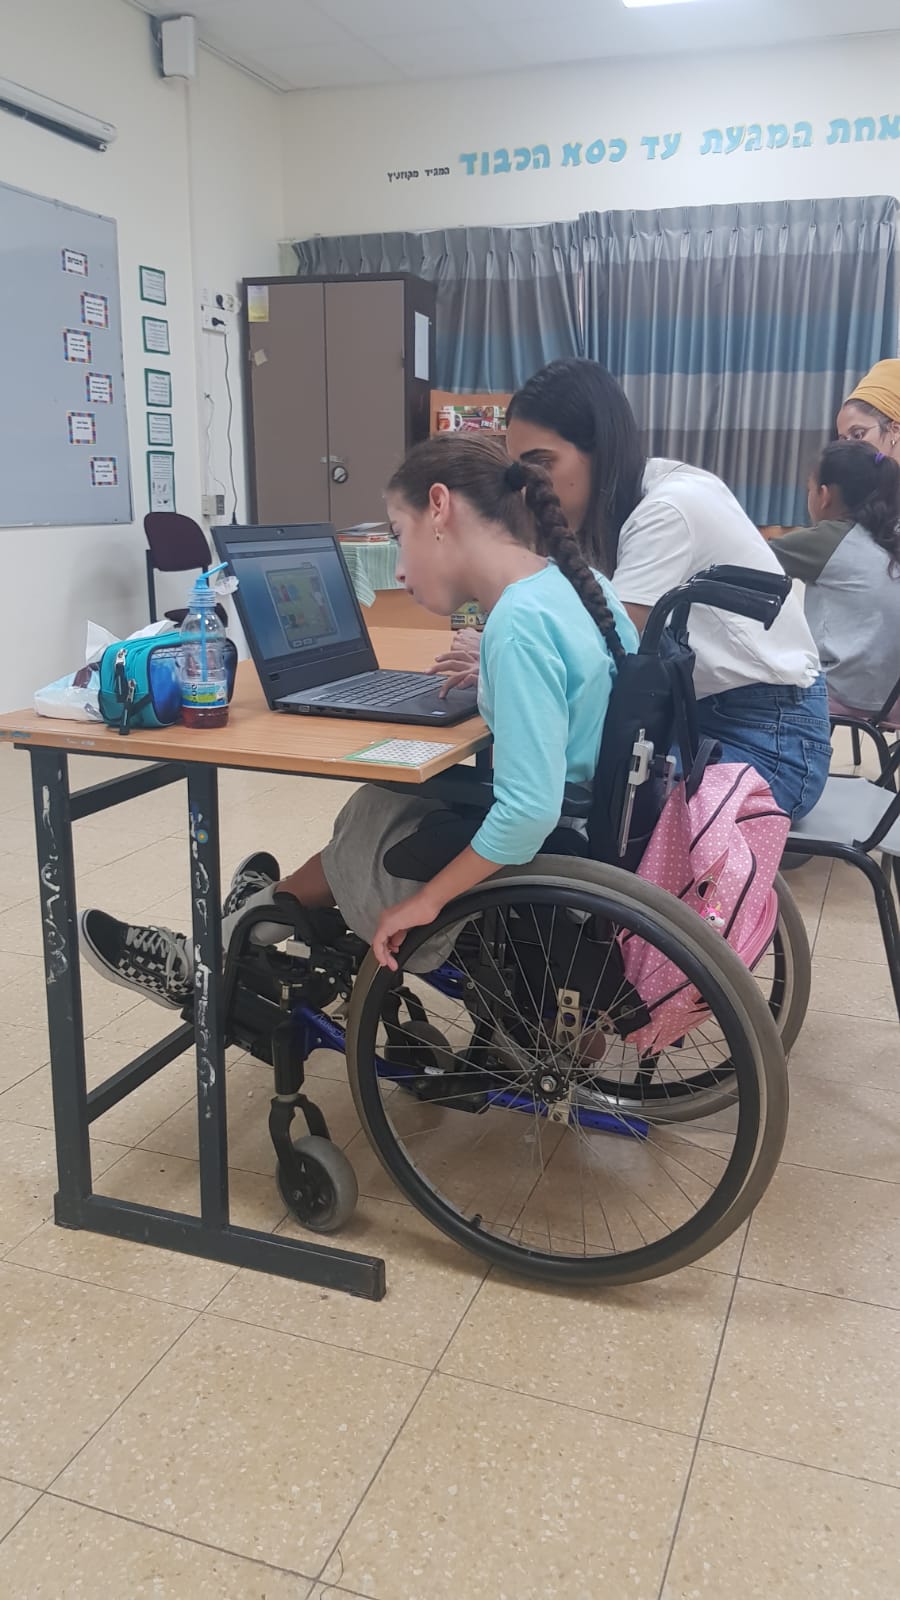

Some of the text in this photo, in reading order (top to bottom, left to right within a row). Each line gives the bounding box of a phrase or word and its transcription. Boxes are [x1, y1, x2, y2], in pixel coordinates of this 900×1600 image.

[459, 113, 900, 176] אחת המגעת עד כסא הכבוד
